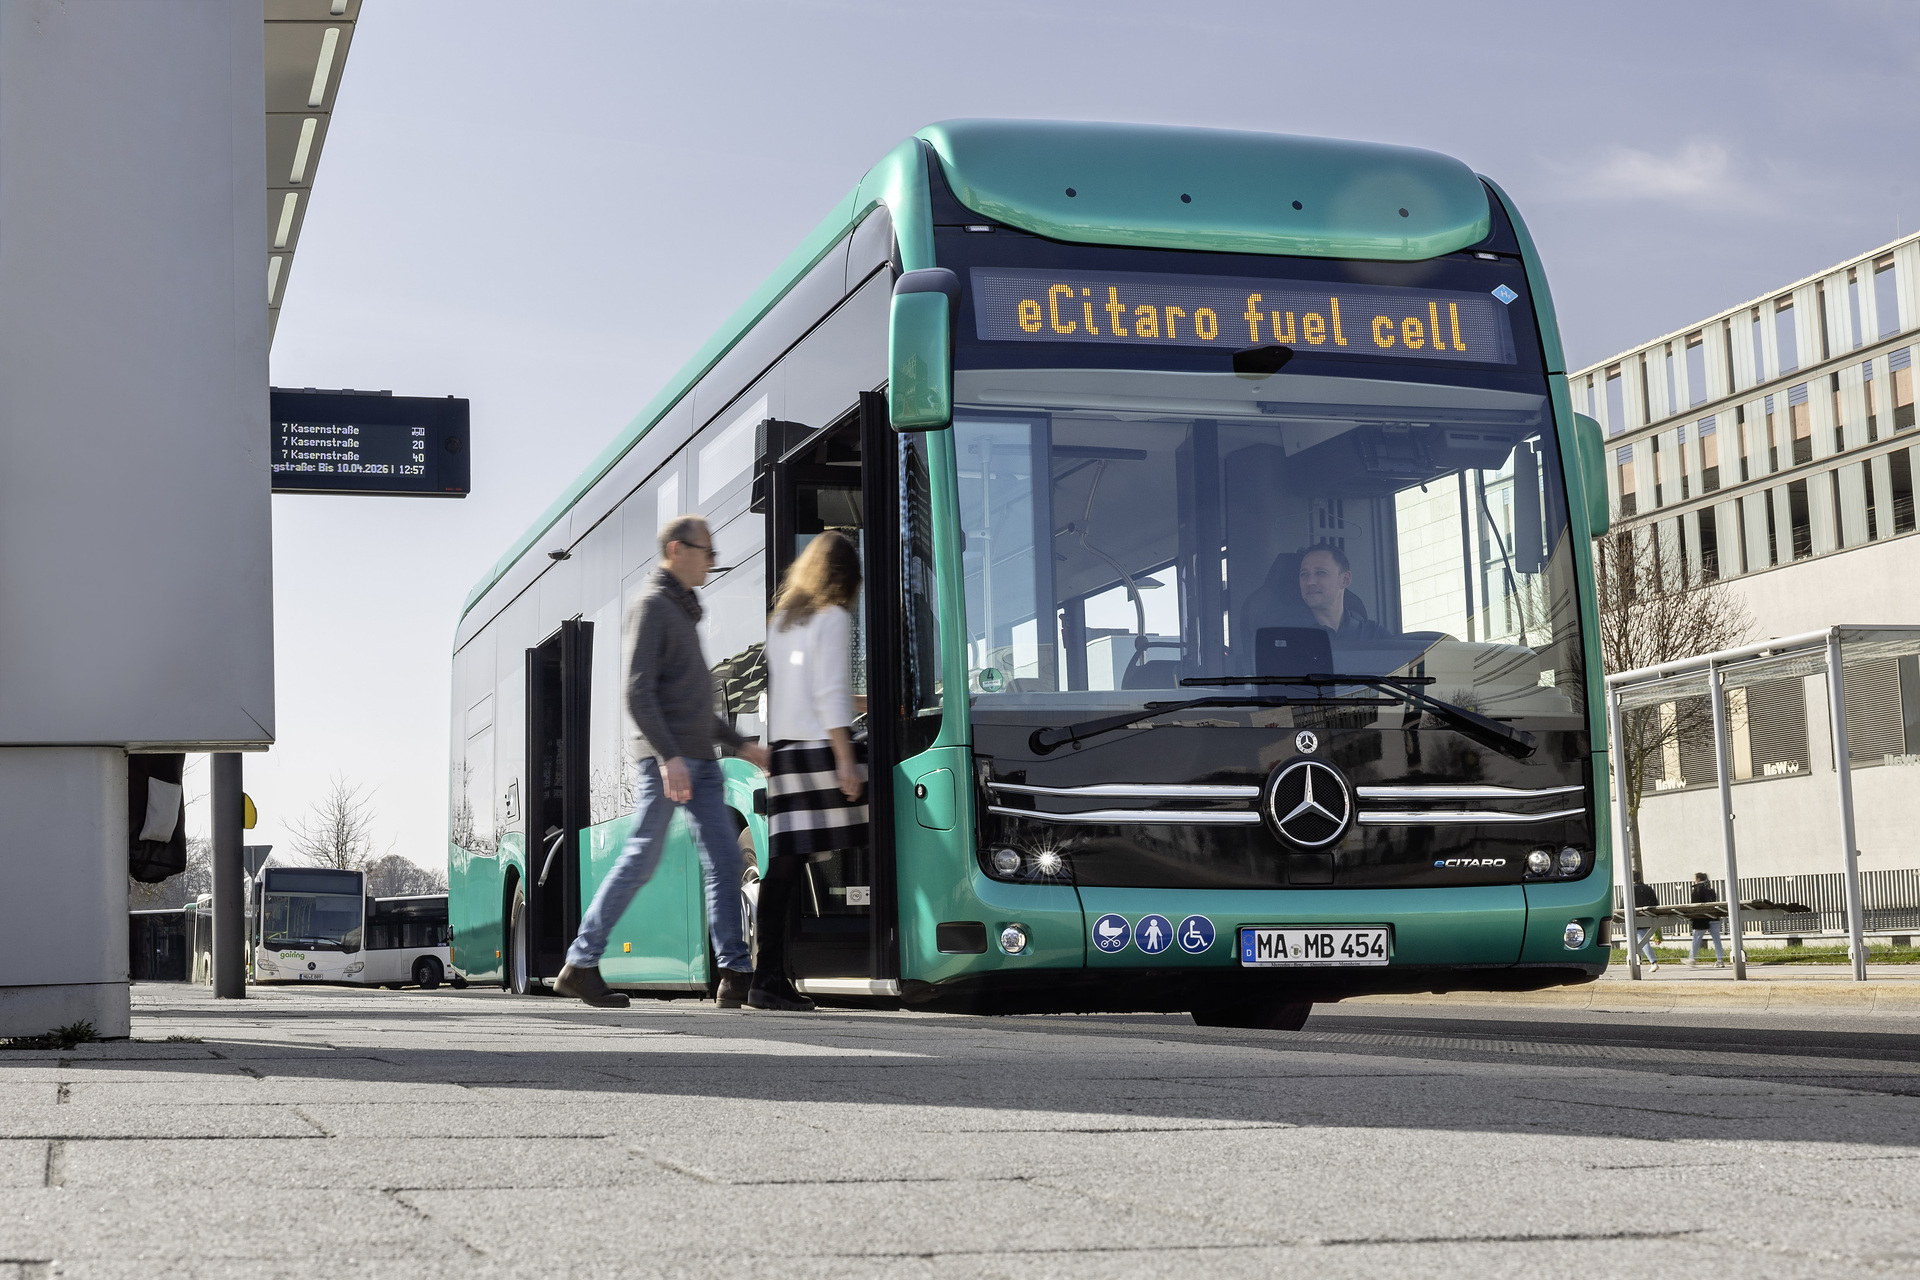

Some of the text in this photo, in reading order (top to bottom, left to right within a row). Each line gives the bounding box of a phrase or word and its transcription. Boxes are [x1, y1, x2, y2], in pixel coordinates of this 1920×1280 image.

[1018, 284, 1466, 351] eCitaro fuel cell
[281, 423, 360, 435] 7 Kasernstraße
[281, 436, 424, 450] 7 Kasernstraße 20
[281, 449, 424, 463] 7 Kasernstraße 40
[318, 462, 334, 472] Bis
[337, 463, 389, 474] 10.04.2026
[399, 465, 425, 475] 12:57
[1433, 858, 1507, 868] eCITARO
[1257, 933, 1384, 959] MA MB 454
[280, 950, 305, 960] gairing
[1246, 949, 1252, 957] D
